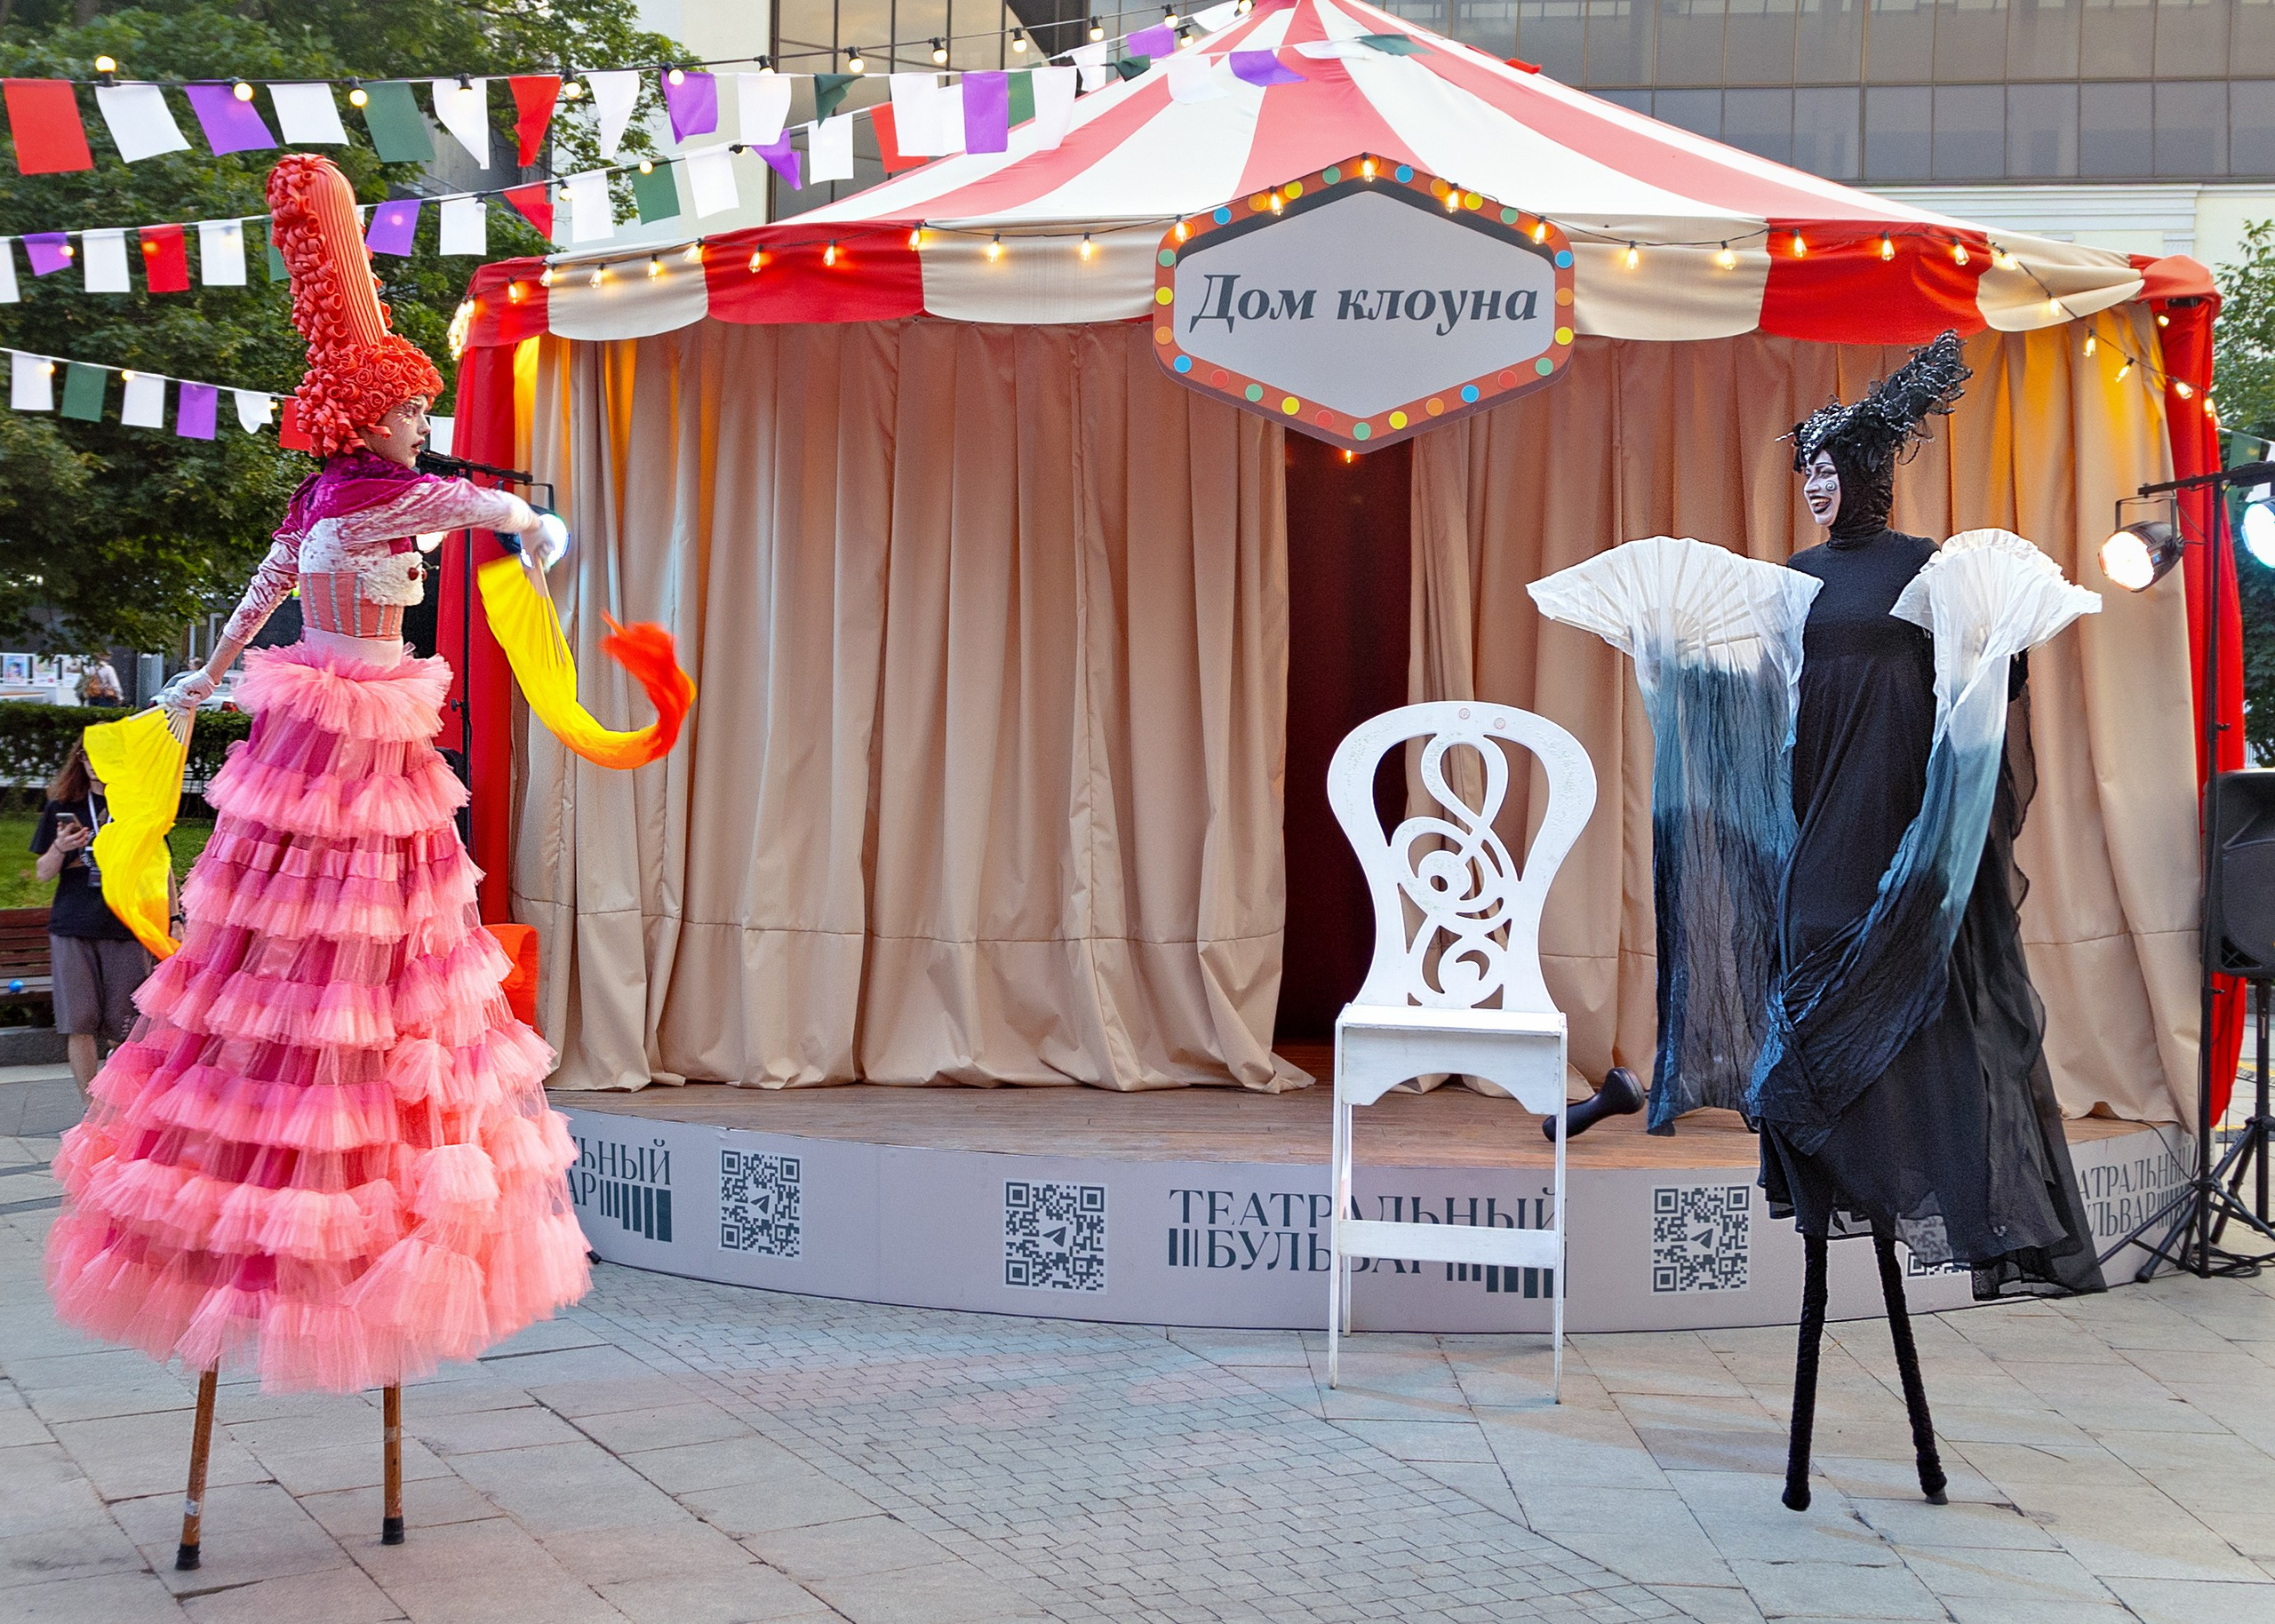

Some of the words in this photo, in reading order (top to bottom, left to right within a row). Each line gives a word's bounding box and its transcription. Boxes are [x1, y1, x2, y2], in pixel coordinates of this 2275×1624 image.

[1188, 274, 1316, 333] Дом
[1336, 288, 1538, 336] клоуна
[2079, 1134, 2191, 1200] АТРАЛЬНЫЙ
[1207, 1228, 1422, 1273] БУЛЬ
